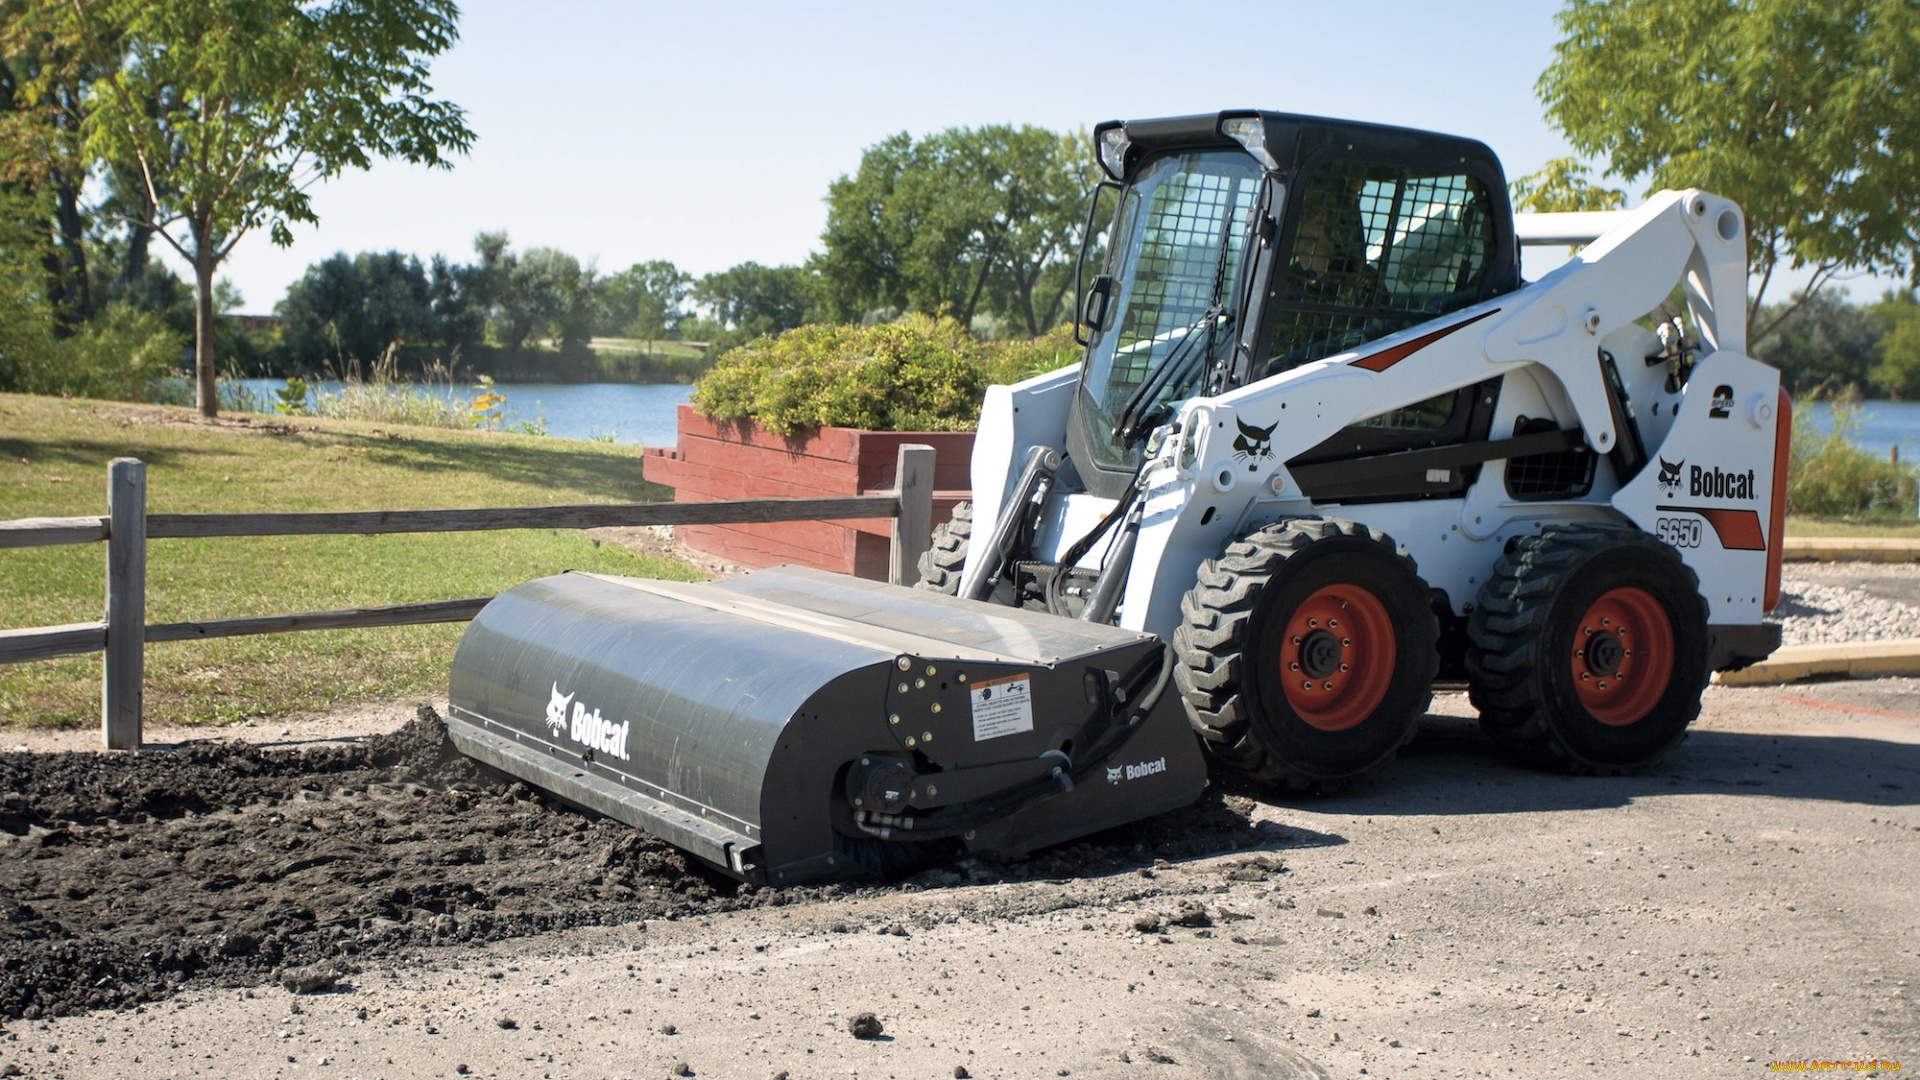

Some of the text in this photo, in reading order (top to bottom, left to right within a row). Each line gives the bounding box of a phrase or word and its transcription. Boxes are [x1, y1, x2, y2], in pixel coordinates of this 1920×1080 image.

[1709, 384, 1734, 419] 2
[1690, 465, 1754, 500] Bobcat
[1656, 517, 1702, 548] S650
[571, 701, 630, 760] Bobcat
[1126, 757, 1166, 780] Bobcat
